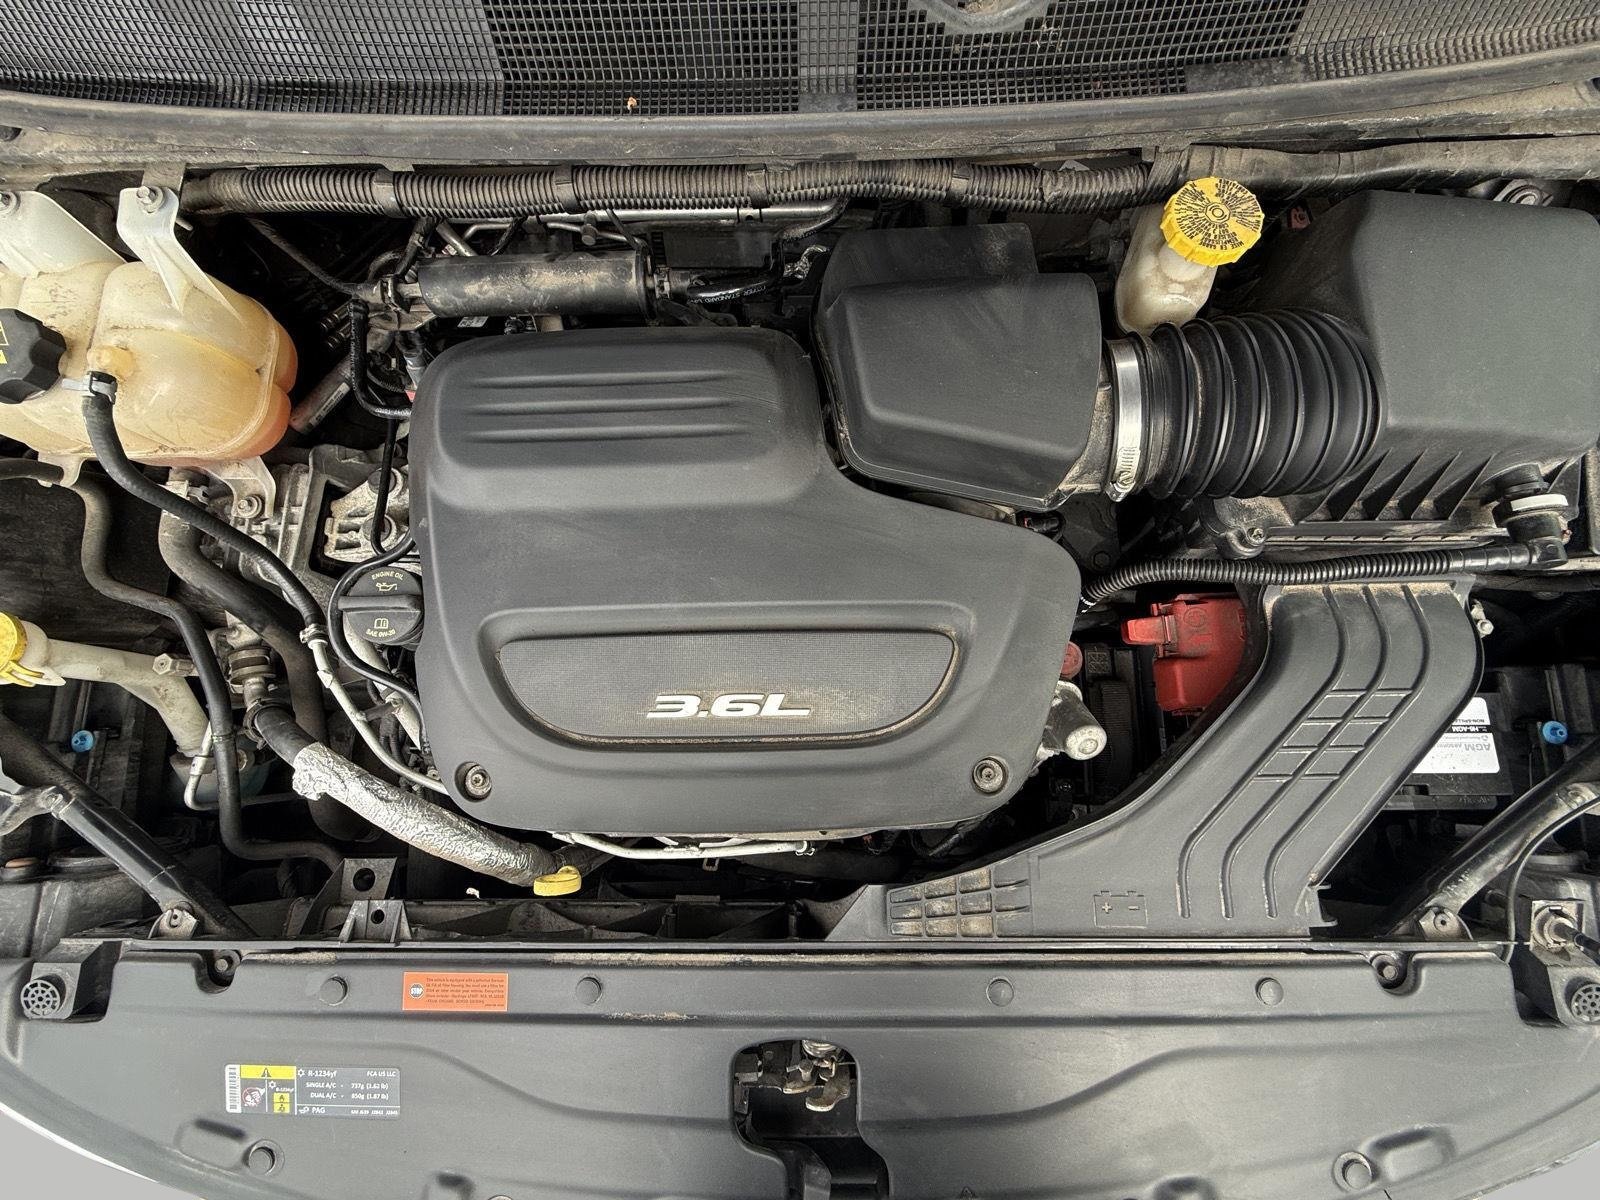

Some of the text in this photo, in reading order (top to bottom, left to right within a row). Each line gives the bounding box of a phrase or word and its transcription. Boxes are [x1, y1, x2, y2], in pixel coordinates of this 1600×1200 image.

[372, 571, 404, 580] ENGINE OIL
[366, 628, 378, 637] SAE
[646, 693, 811, 718] 3.6L
[1465, 743, 1491, 751] AGM
[308, 1070, 337, 1079] R-1234yf
